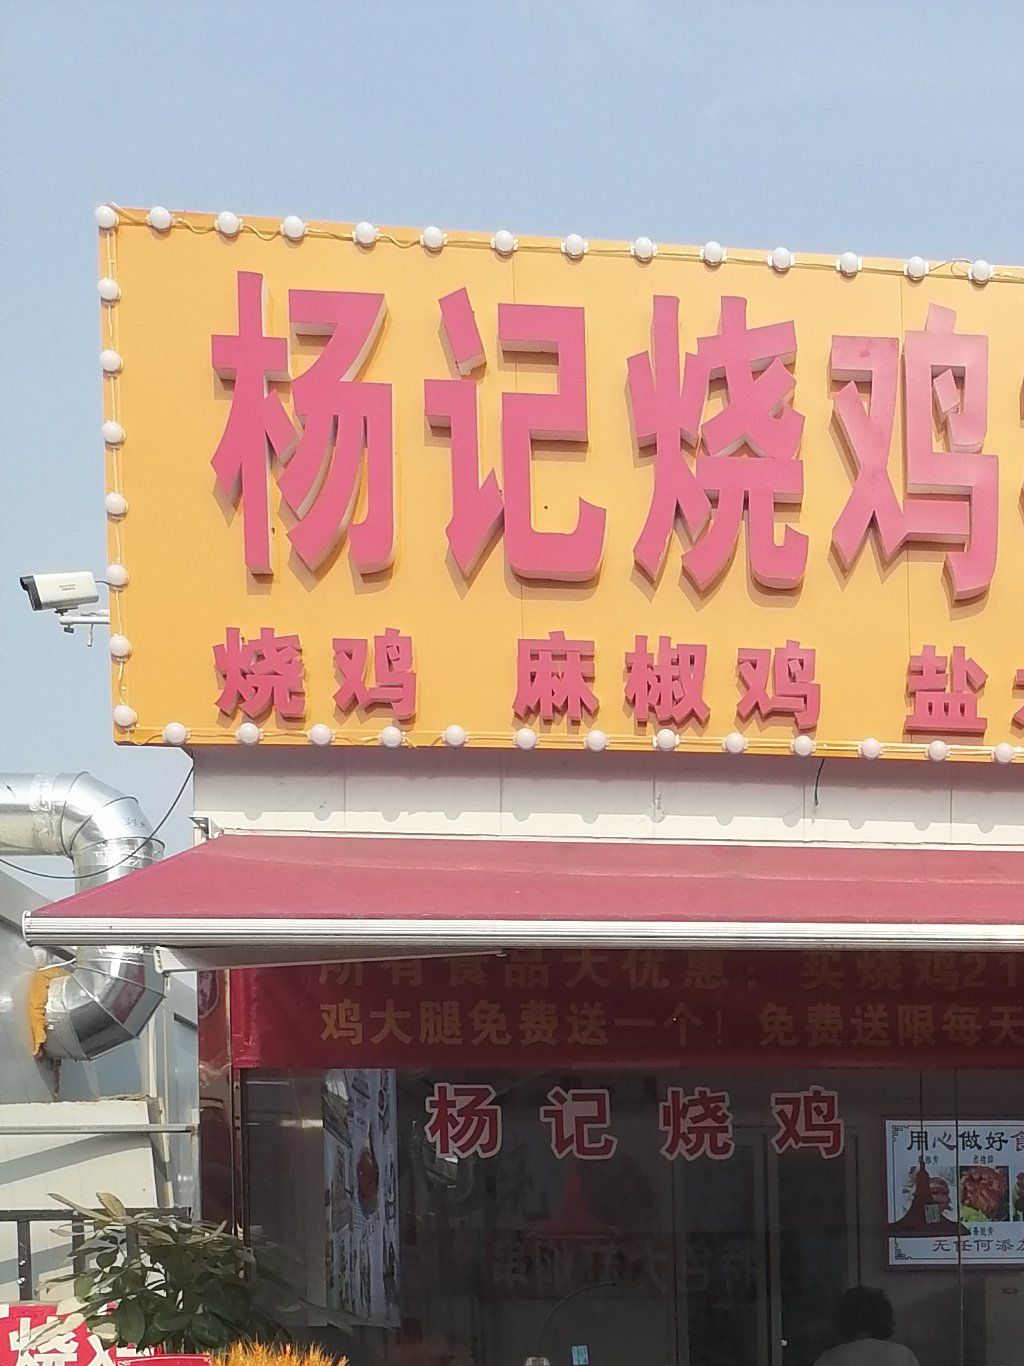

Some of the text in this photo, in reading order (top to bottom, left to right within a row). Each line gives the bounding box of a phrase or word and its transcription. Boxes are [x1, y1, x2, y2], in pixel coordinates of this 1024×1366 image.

[214, 627, 418, 720] 烧鸡
[512, 632, 821, 732] 麻椒鸡
[426, 1083, 844, 1160] 杨记烧鸡
